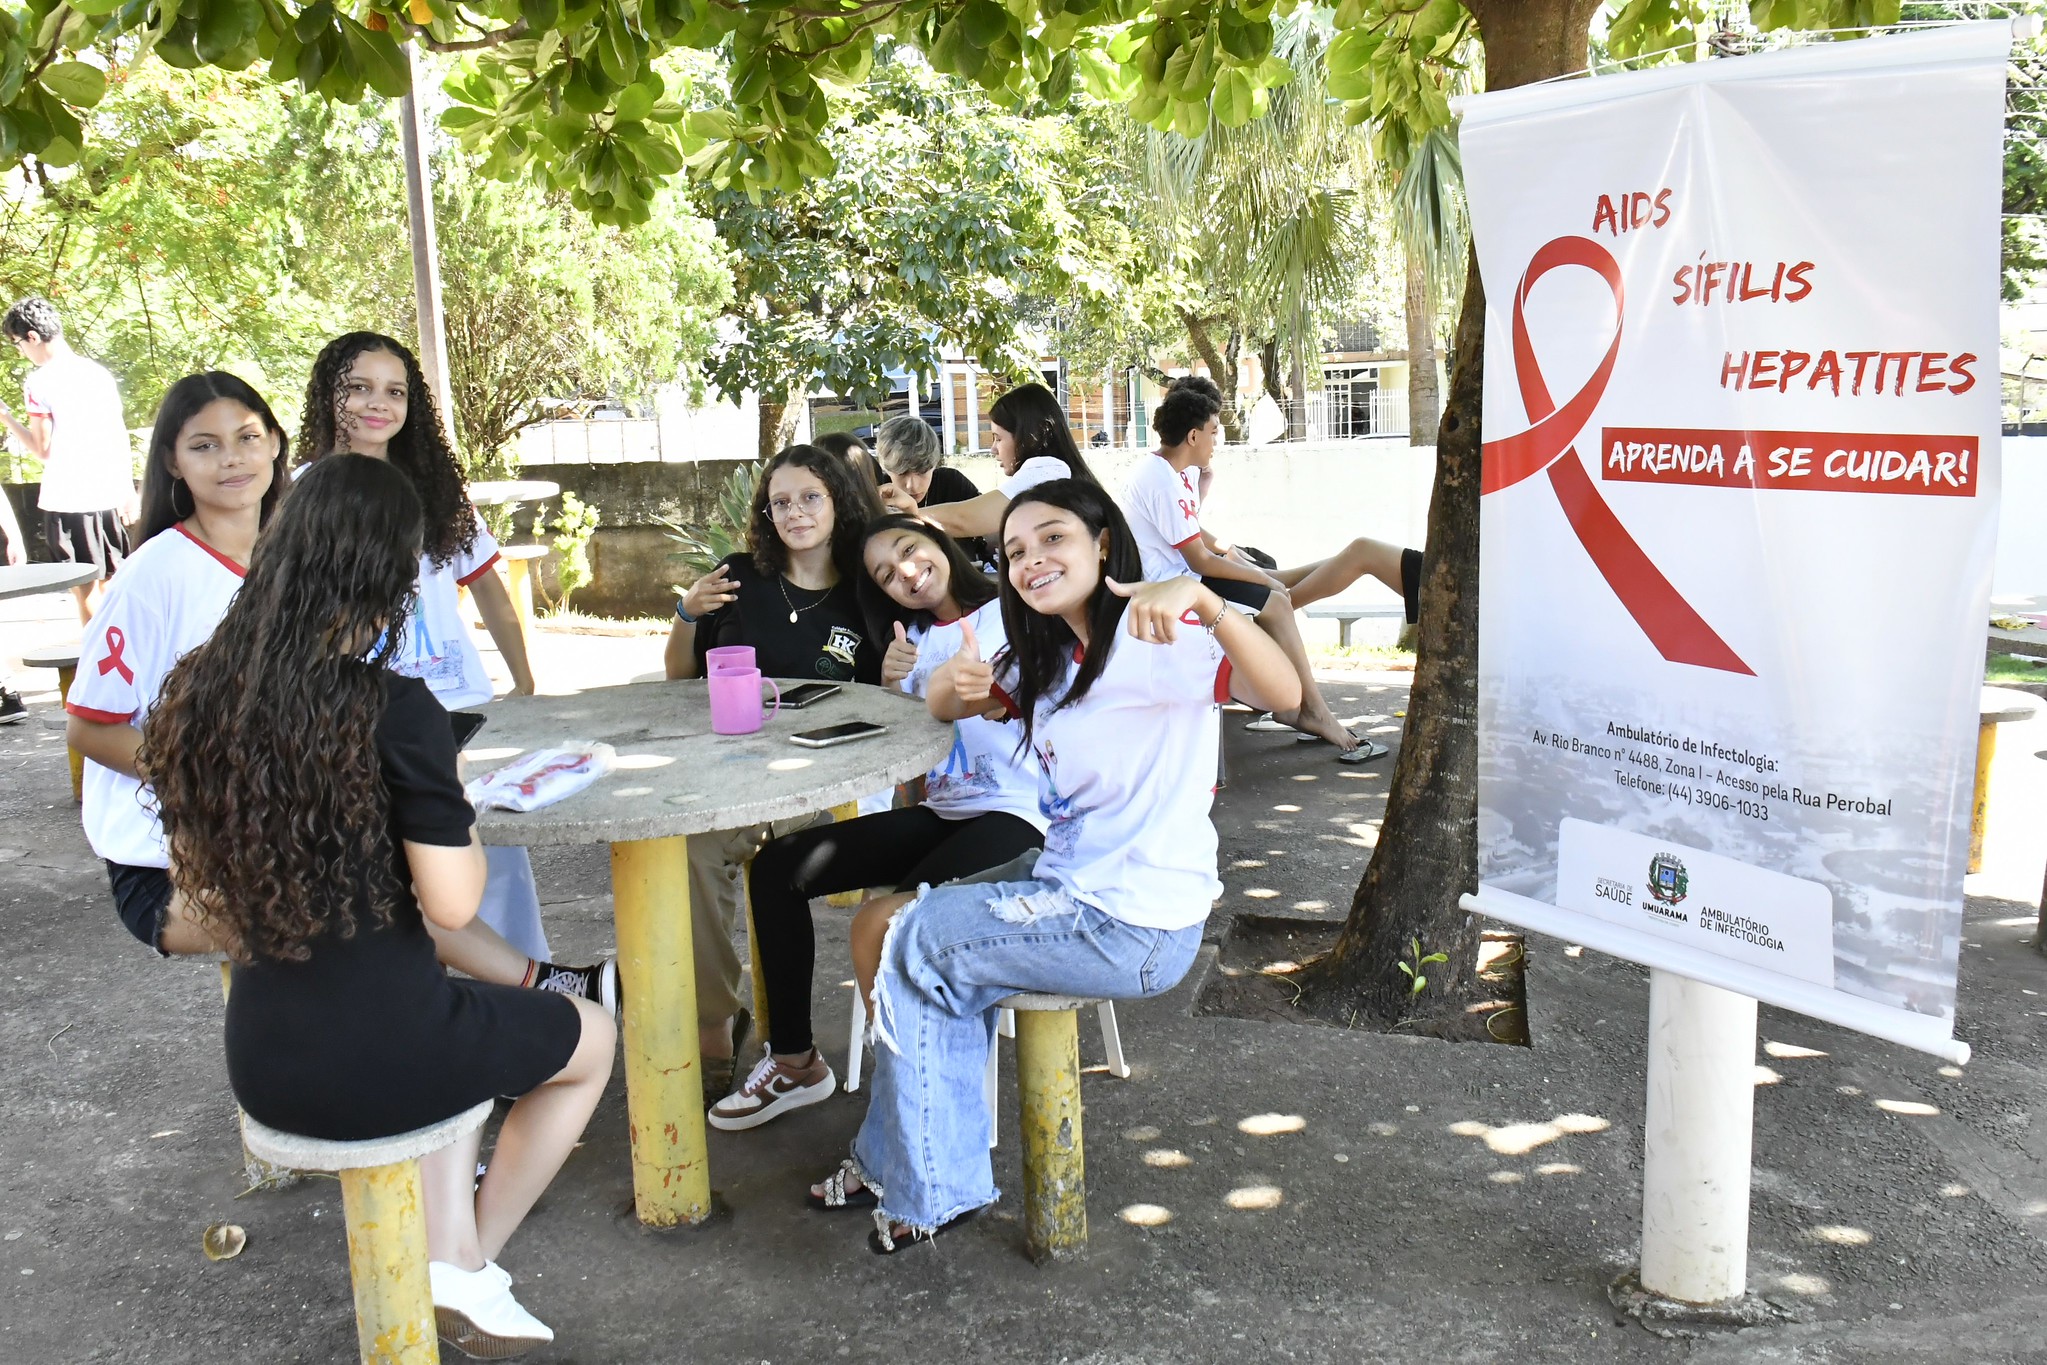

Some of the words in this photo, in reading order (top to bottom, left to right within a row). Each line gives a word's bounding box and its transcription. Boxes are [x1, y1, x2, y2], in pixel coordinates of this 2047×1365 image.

[1592, 187, 1673, 237] AIDS
[1672, 250, 1816, 306] SÍFILIS
[1720, 349, 1978, 398] HEPATITES
[1608, 440, 1725, 478] APRENDA
[1730, 445, 1756, 479] A
[1767, 447, 1813, 478] SE
[1823, 449, 1971, 488] CUIDAR!
[1606, 721, 1680, 750] Ambulatório
[1682, 736, 1697, 753] de
[1700, 740, 1779, 773] Infectologia:
[1532, 730, 1549, 746] Av.
[1552, 733, 1569, 750] Rio
[1571, 737, 1611, 759] Branco
[1628, 750, 1662, 773] 4488,
[1665, 757, 1695, 779] Zona
[1716, 769, 1759, 794] Acesso
[1762, 783, 1788, 802] pela
[1792, 787, 1821, 808] Rua
[1826, 793, 1892, 816] Perobal
[1614, 769, 1665, 796] Telefone:
[1667, 782, 1693, 806] (44)
[1695, 788, 1769, 821] 3906-1033
[1595, 883, 1633, 906] SAÚDE
[1597, 876, 1626, 890] SECRETARIA
[1642, 901, 1688, 923] UMUARAMA
[1700, 906, 1770, 936] AMBULATÓRIO
[1700, 917, 1713, 931] DE
[1714, 920, 1785, 952] INFECTOLOGIA
